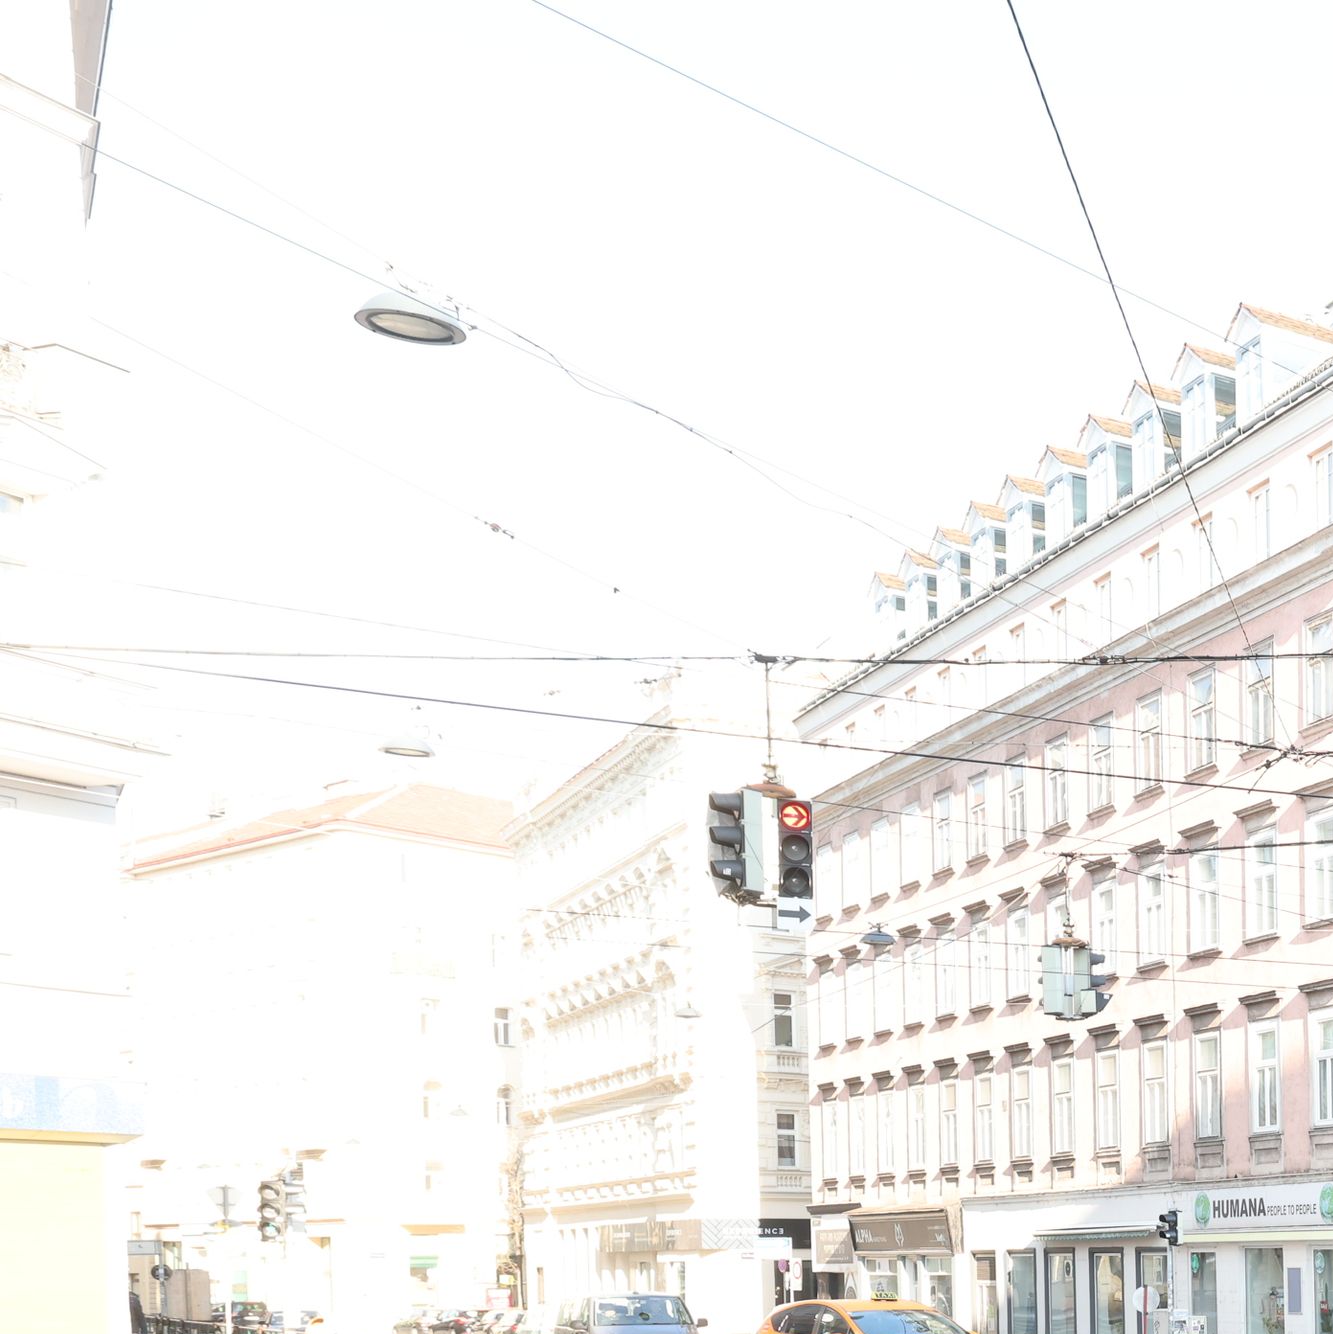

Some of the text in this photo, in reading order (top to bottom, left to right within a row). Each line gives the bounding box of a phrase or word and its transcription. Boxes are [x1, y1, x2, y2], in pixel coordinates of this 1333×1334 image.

[1212, 1197, 1317, 1218] HUMANA PEOPLE TO PEOPLE
